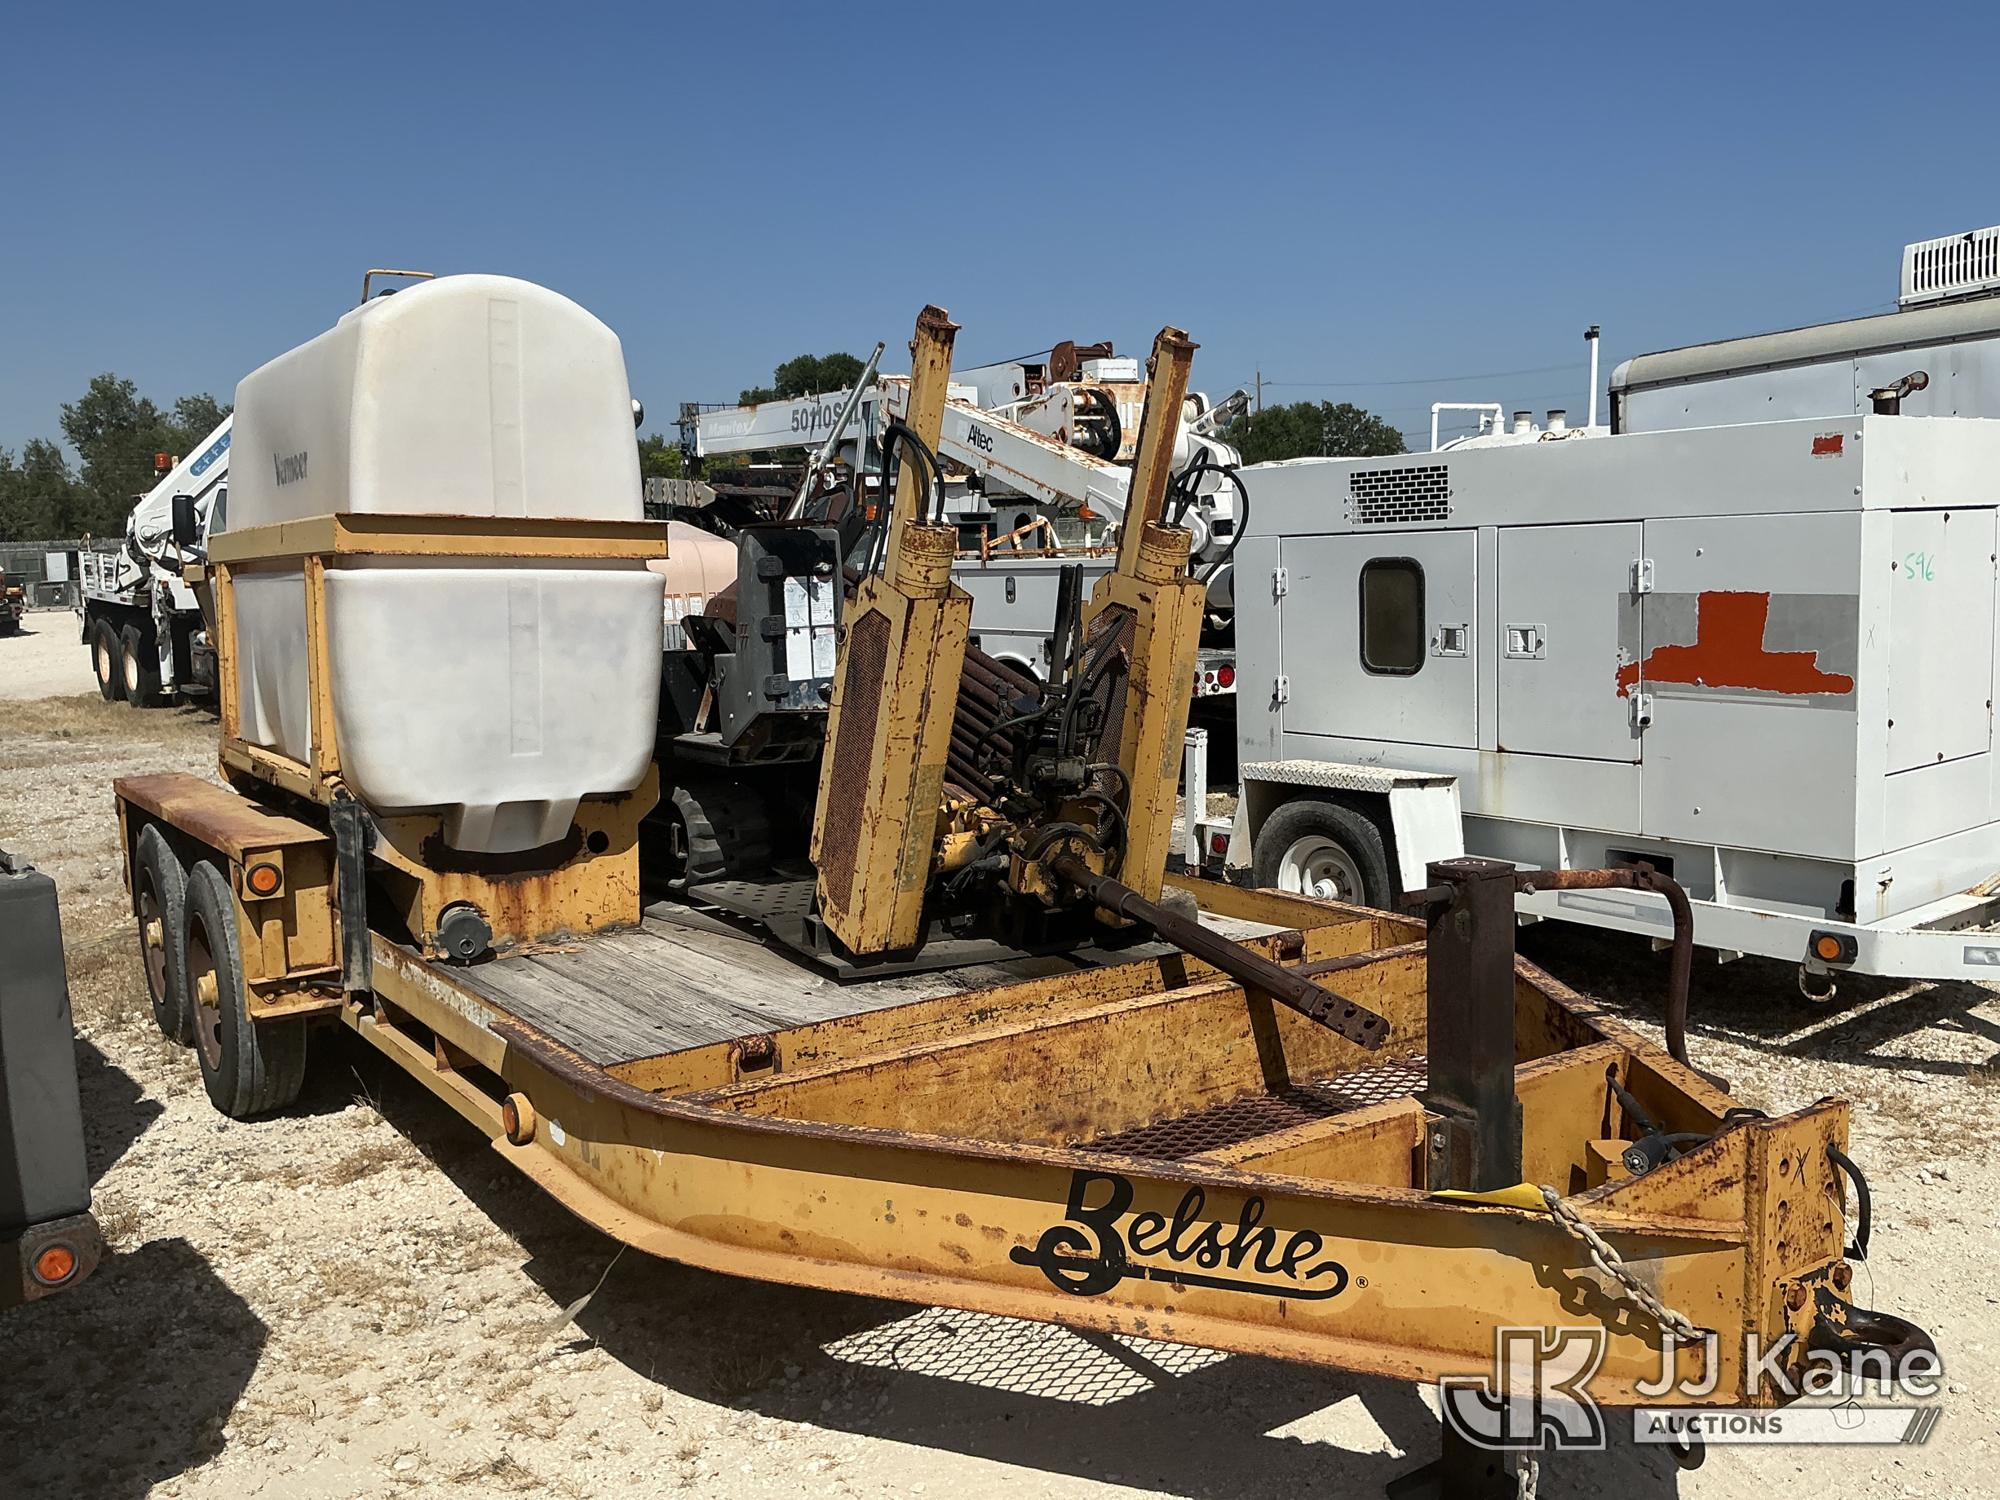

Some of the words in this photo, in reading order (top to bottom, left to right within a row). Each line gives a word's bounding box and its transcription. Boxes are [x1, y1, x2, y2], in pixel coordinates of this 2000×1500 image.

[193, 430, 231, 473] EFFE
[967, 423, 993, 453] Altec
[1904, 551, 1936, 582] 596
[1009, 1171, 1349, 1300] Belshe
